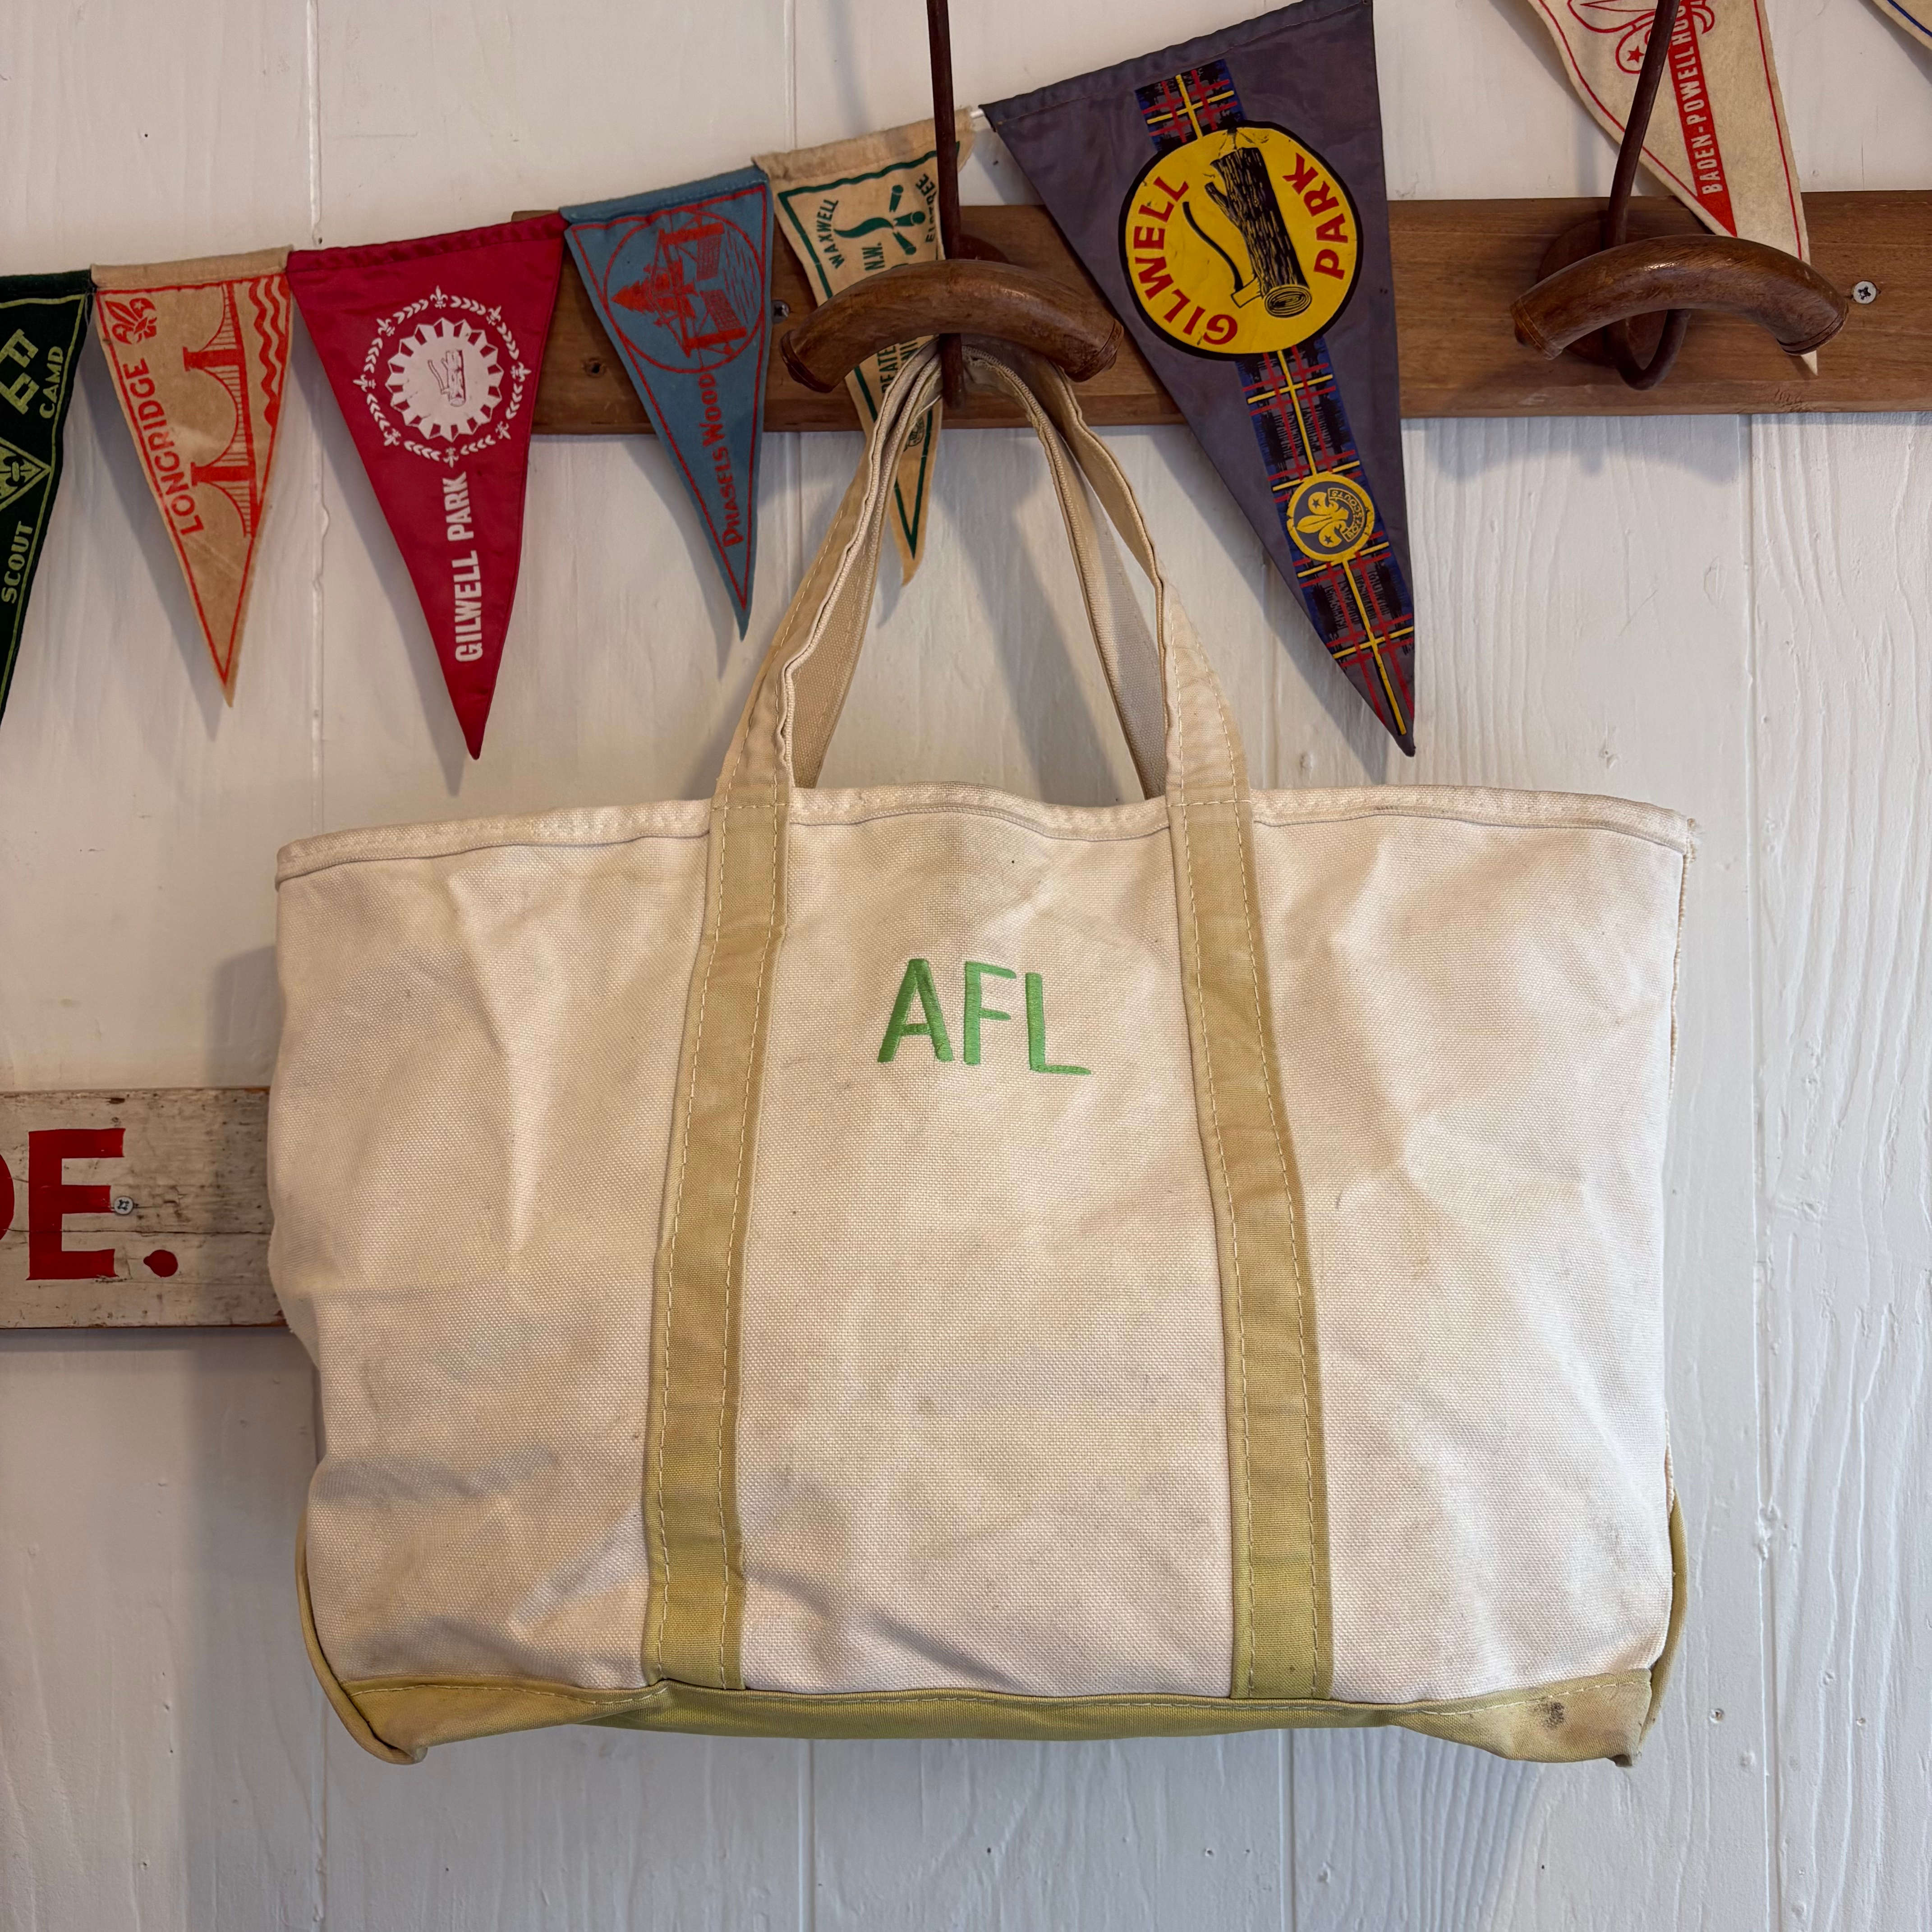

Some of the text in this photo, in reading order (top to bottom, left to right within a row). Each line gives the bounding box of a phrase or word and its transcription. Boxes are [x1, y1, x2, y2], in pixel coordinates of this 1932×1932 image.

[1674, 46, 1723, 194] BADEN-POWELL
[1134, 153, 1348, 345] GILWELL PARK
[123, 358, 204, 535] LONGRIDGE
[1331, 490, 1362, 519] SCOUTS
[1, 520, 33, 603] SCOUT
[442, 470, 483, 662] GILWELL PARK
[877, 958, 1091, 1075] AFL
[0, 1128, 178, 1280] E.
